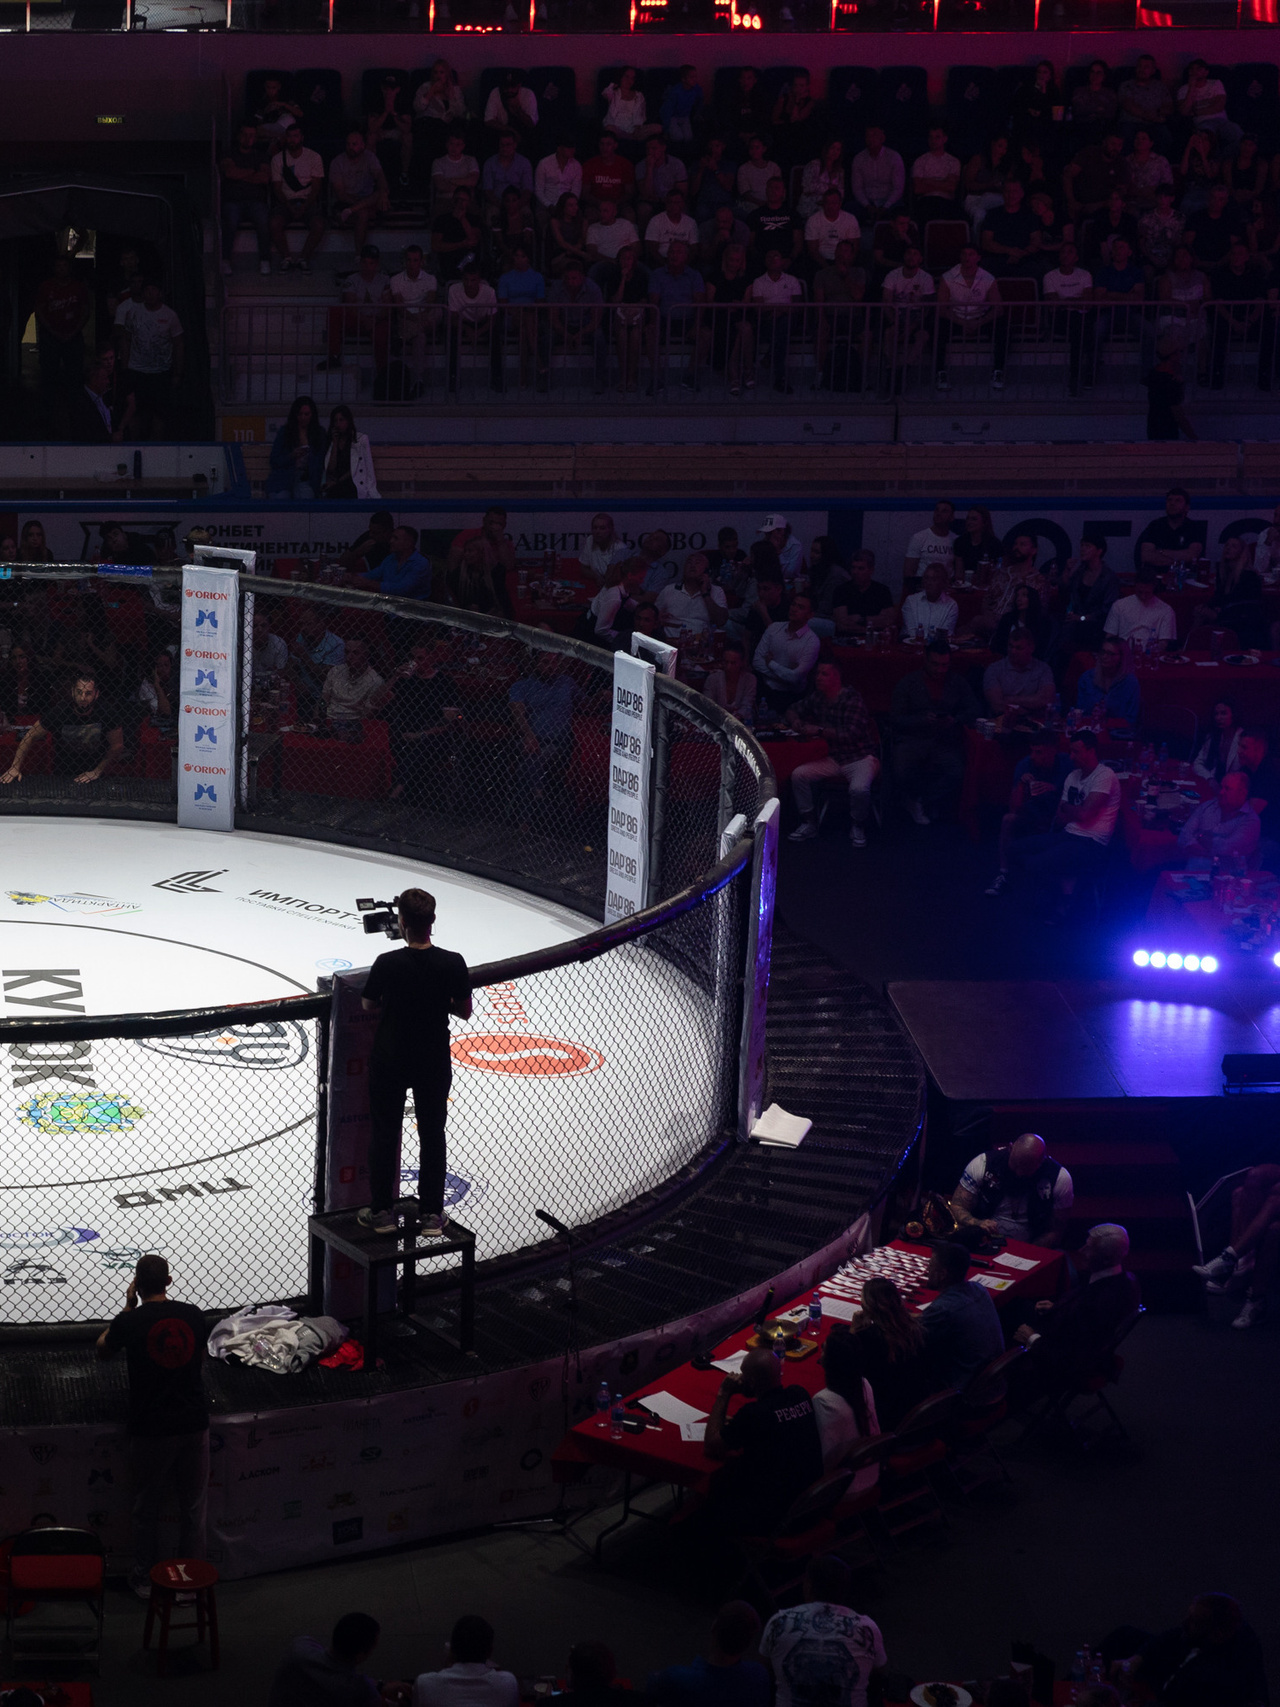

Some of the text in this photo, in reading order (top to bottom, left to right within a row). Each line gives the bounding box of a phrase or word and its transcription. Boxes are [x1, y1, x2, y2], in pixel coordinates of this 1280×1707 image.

[195, 590, 228, 601] ORION
[194, 650, 227, 661] ORION
[193, 706, 227, 717] ORION
[193, 765, 226, 775] ORION
[249, 889, 364, 925] ИМПОРТ-
[235, 896, 357, 931] ПОСТАВКИ СПЕЦТЕХНИКИ
[1, 968, 97, 1088] КУОК
